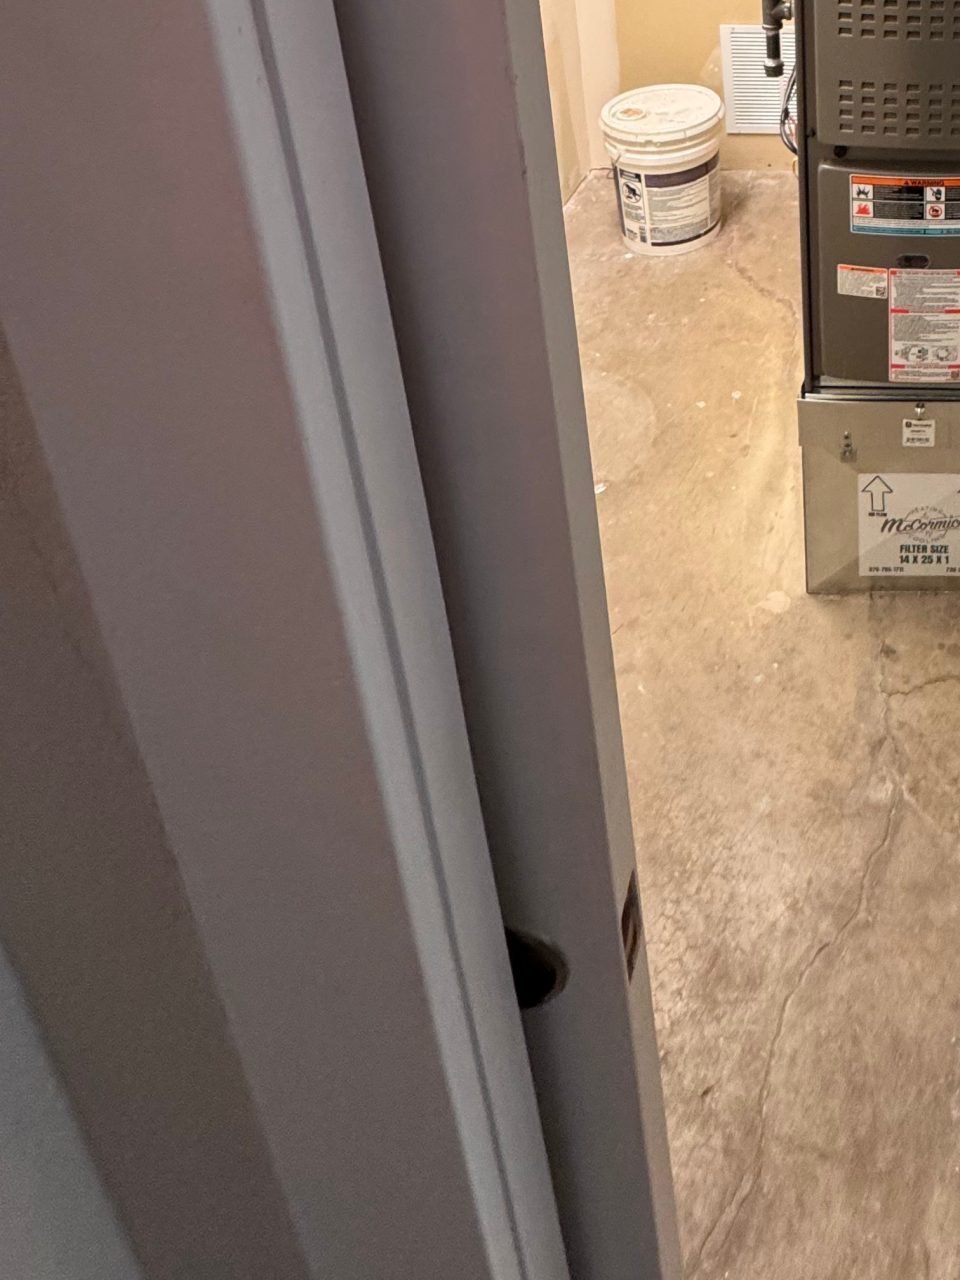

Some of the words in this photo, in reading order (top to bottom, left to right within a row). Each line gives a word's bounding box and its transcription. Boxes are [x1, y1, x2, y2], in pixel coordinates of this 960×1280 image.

[911, 179, 945, 187] WARNING
[900, 544, 928, 554] FILTER
[930, 544, 949, 554] SIZE
[900, 555, 910, 564] 14
[912, 555, 918, 564] X
[921, 555, 934, 564] 25
[936, 555, 942, 564] X
